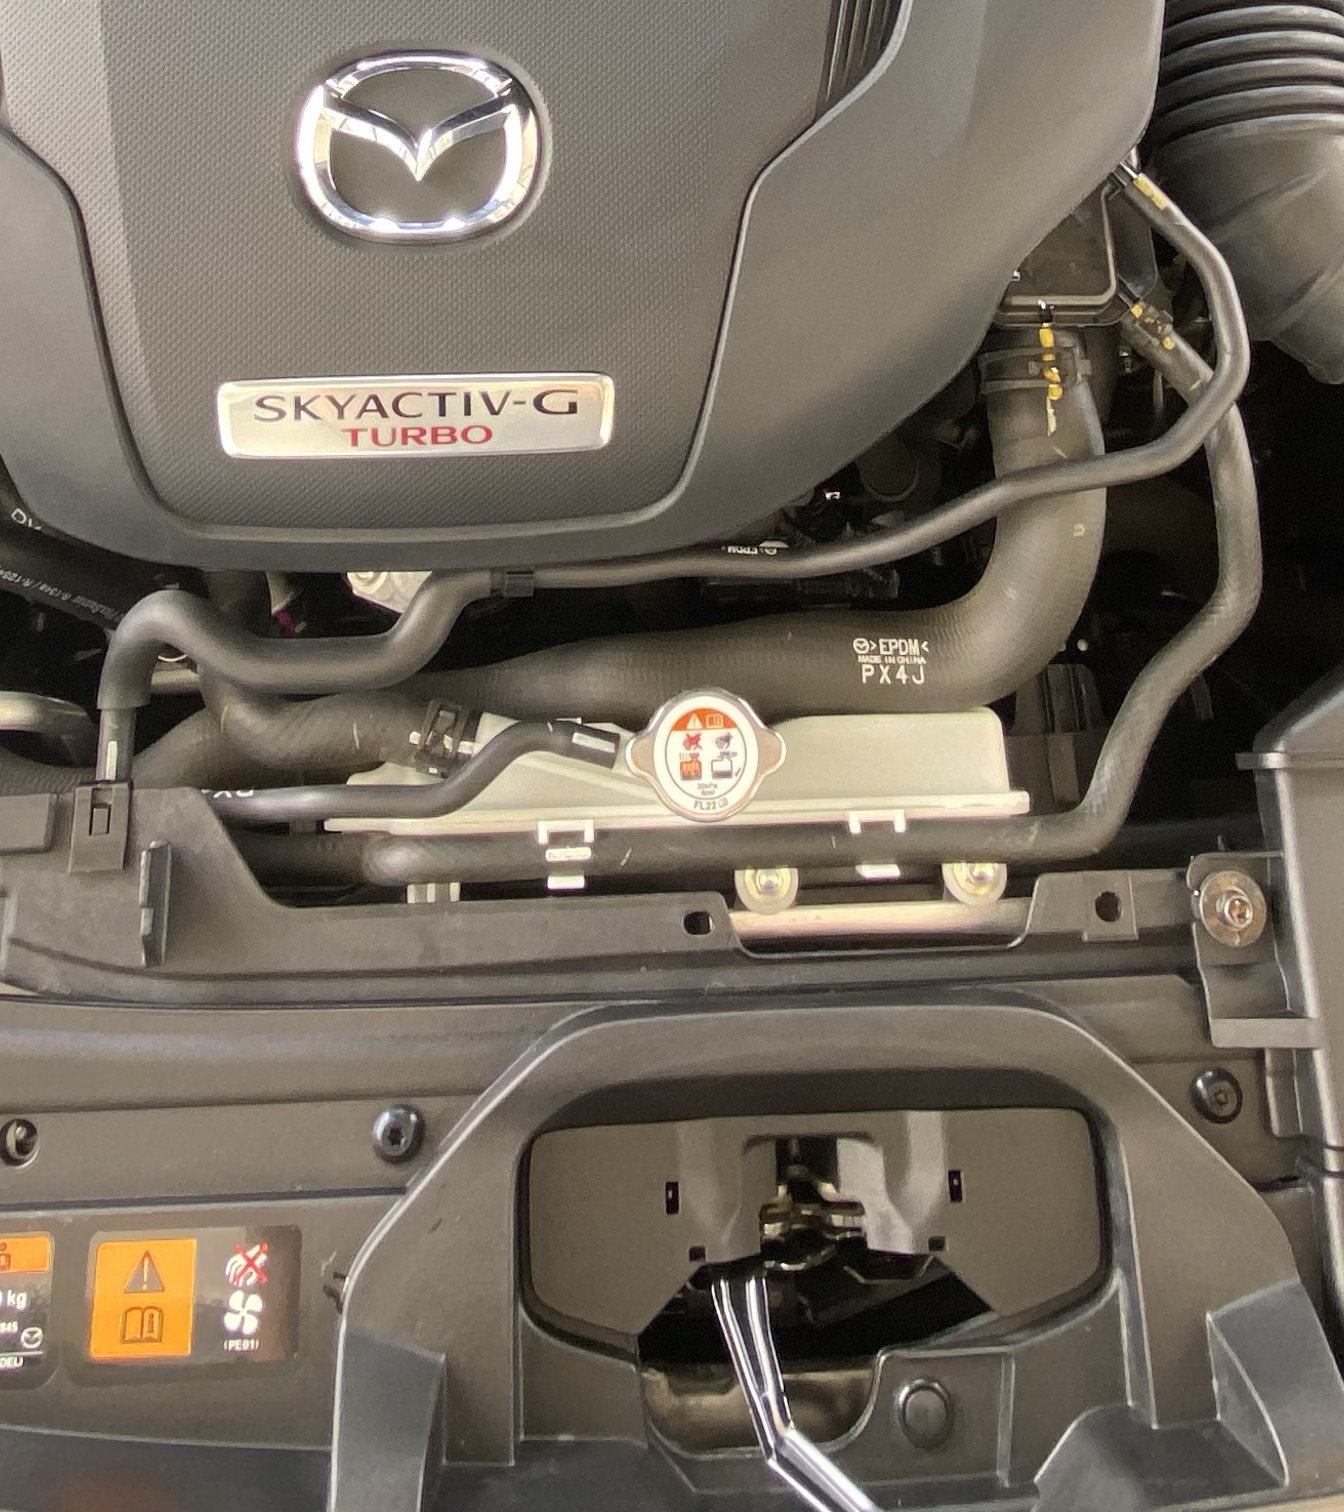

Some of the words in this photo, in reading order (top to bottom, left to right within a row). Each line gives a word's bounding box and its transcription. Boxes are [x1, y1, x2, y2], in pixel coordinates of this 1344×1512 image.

[253, 388, 579, 421] SKYACTIV-G
[342, 424, 494, 448] TURBO
[858, 655, 882, 664] MADE
[884, 655, 896, 664] IN
[896, 655, 927, 664] CHINA
[861, 664, 926, 684] PX4J
[693, 799, 717, 811] FL22
[6, 1290, 27, 1312] kg
